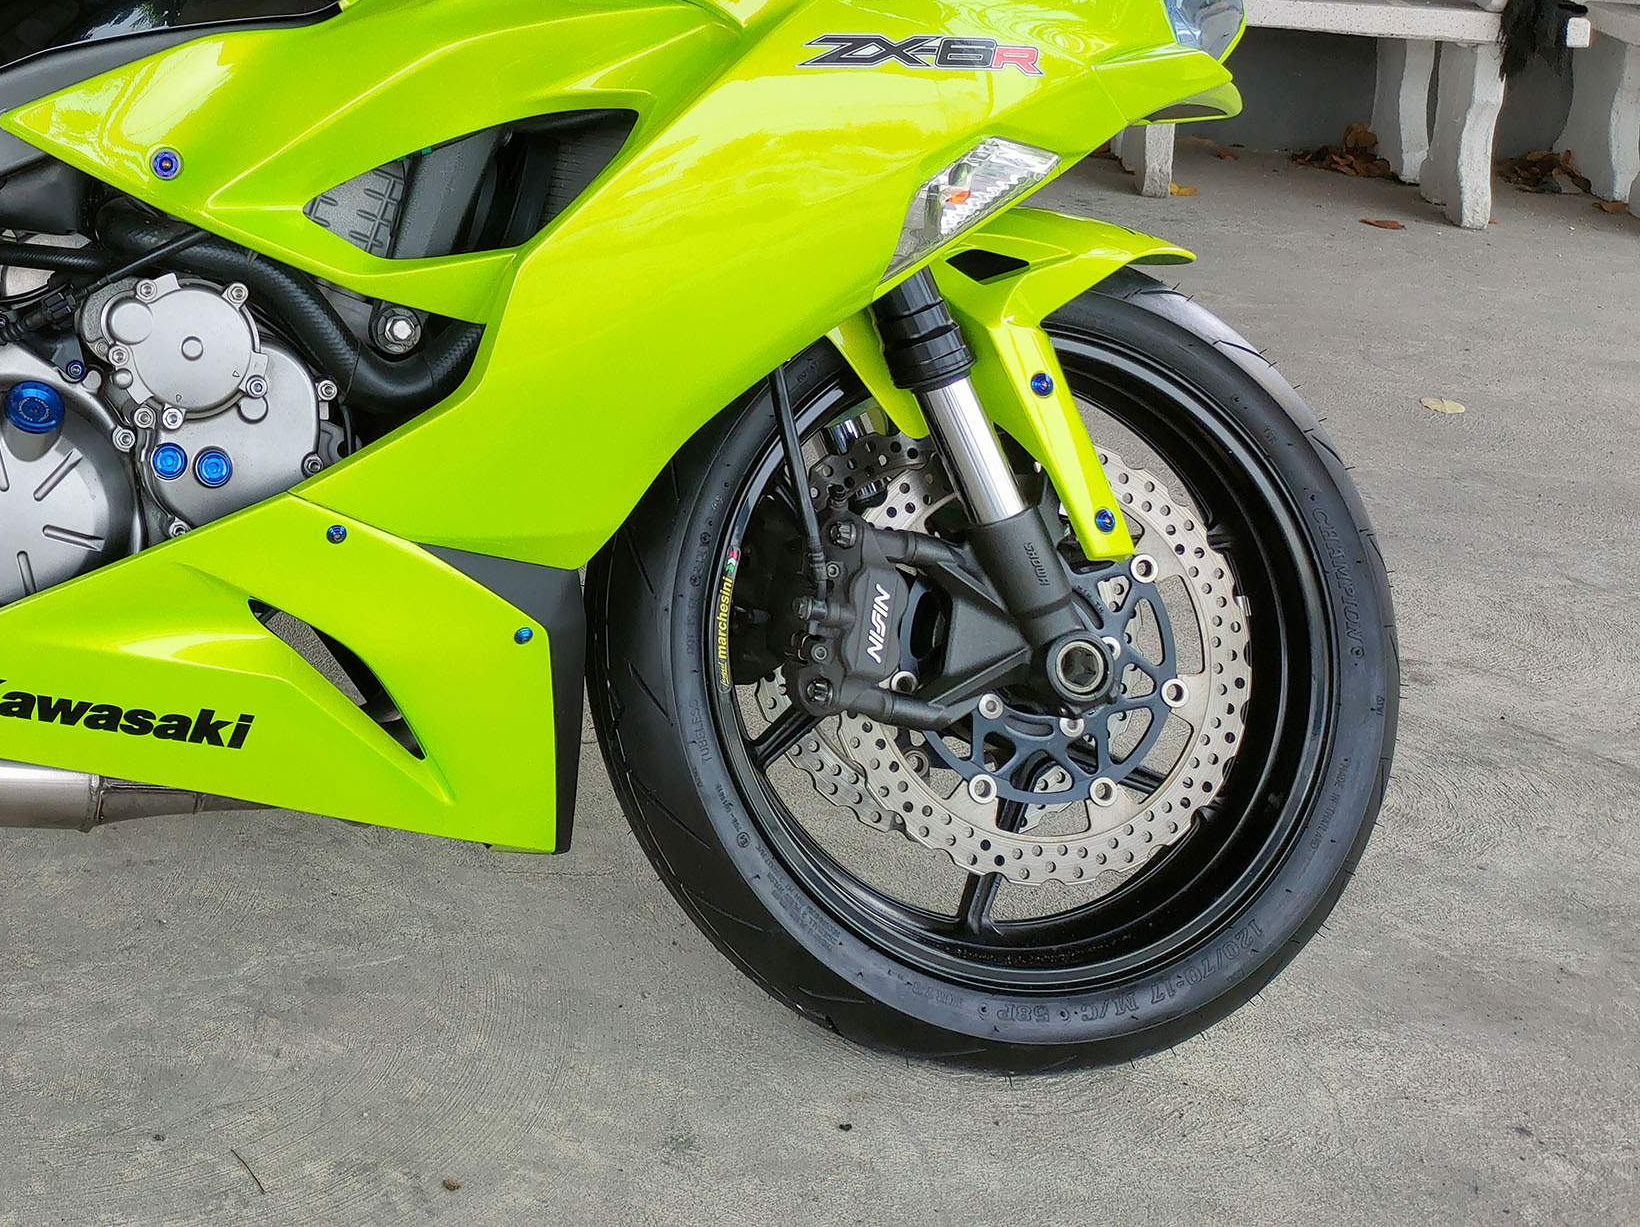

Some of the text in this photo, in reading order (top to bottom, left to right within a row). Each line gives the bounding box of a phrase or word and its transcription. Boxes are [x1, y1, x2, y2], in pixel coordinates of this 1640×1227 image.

[795, 34, 1045, 76] ZX-6R
[1312, 507, 1364, 642] CHAMPION
[718, 576, 733, 660] marchesini
[867, 584, 891, 663] NISSIN
